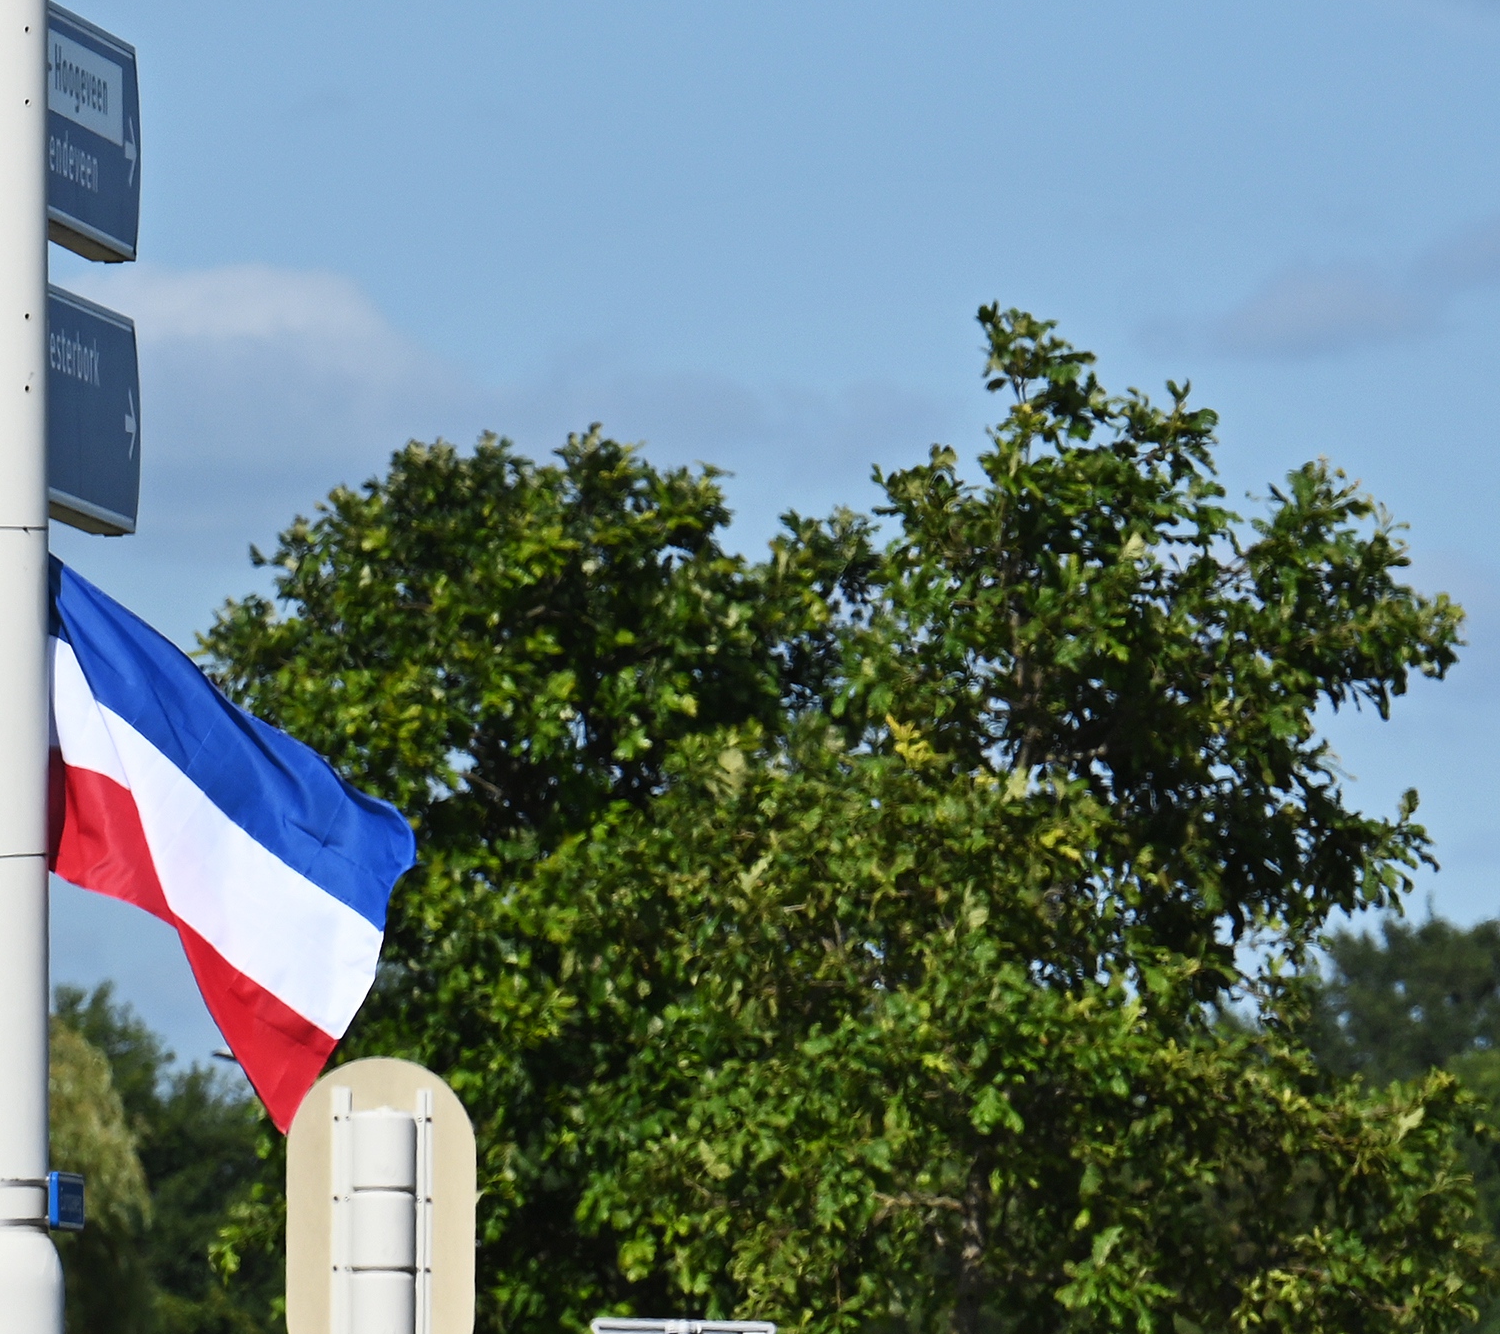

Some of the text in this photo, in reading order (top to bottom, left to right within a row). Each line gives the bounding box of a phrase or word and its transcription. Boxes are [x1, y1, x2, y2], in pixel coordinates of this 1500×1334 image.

[54, 42, 109, 116] Hoogeveen
[50, 129, 99, 194] endeveen
[49, 327, 100, 387] esterbork
